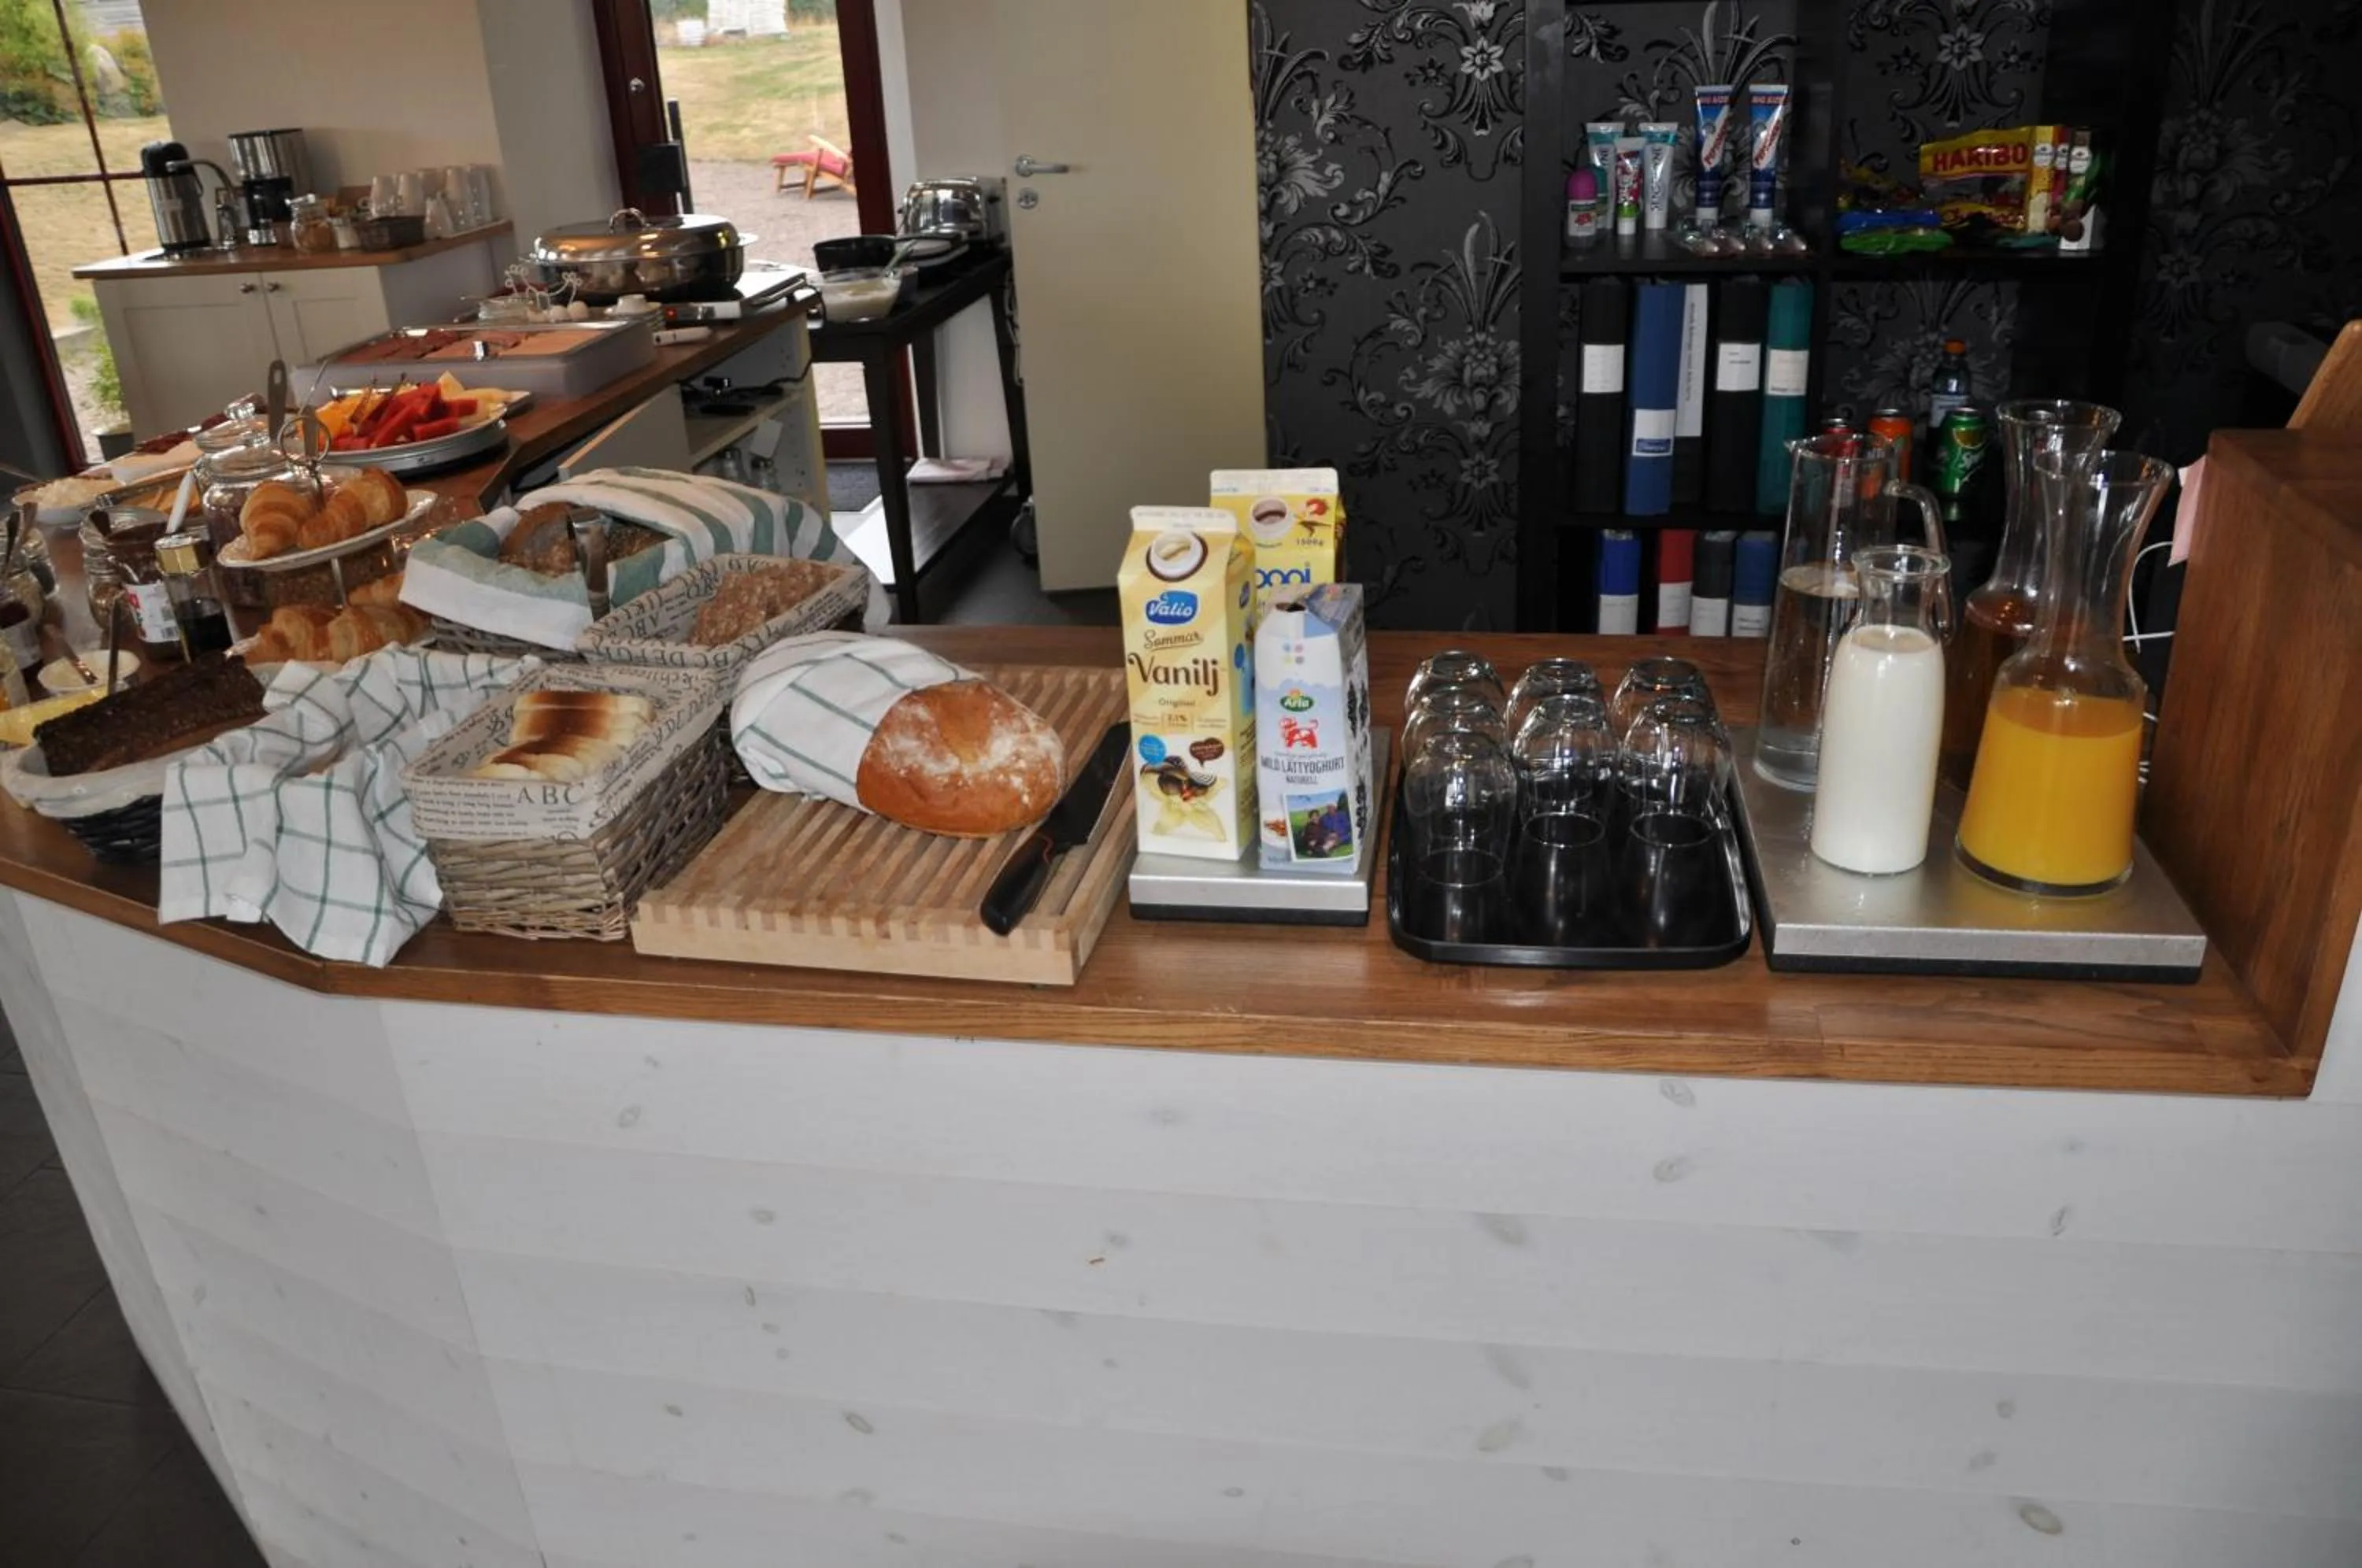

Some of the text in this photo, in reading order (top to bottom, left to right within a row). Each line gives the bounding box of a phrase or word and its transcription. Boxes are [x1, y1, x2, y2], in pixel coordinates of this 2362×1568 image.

[1933, 142, 2027, 172] HARIBO
[1149, 601, 1194, 616] Valio
[1127, 652, 1219, 697] Vanilj
[1284, 697, 1310, 708] Arla
